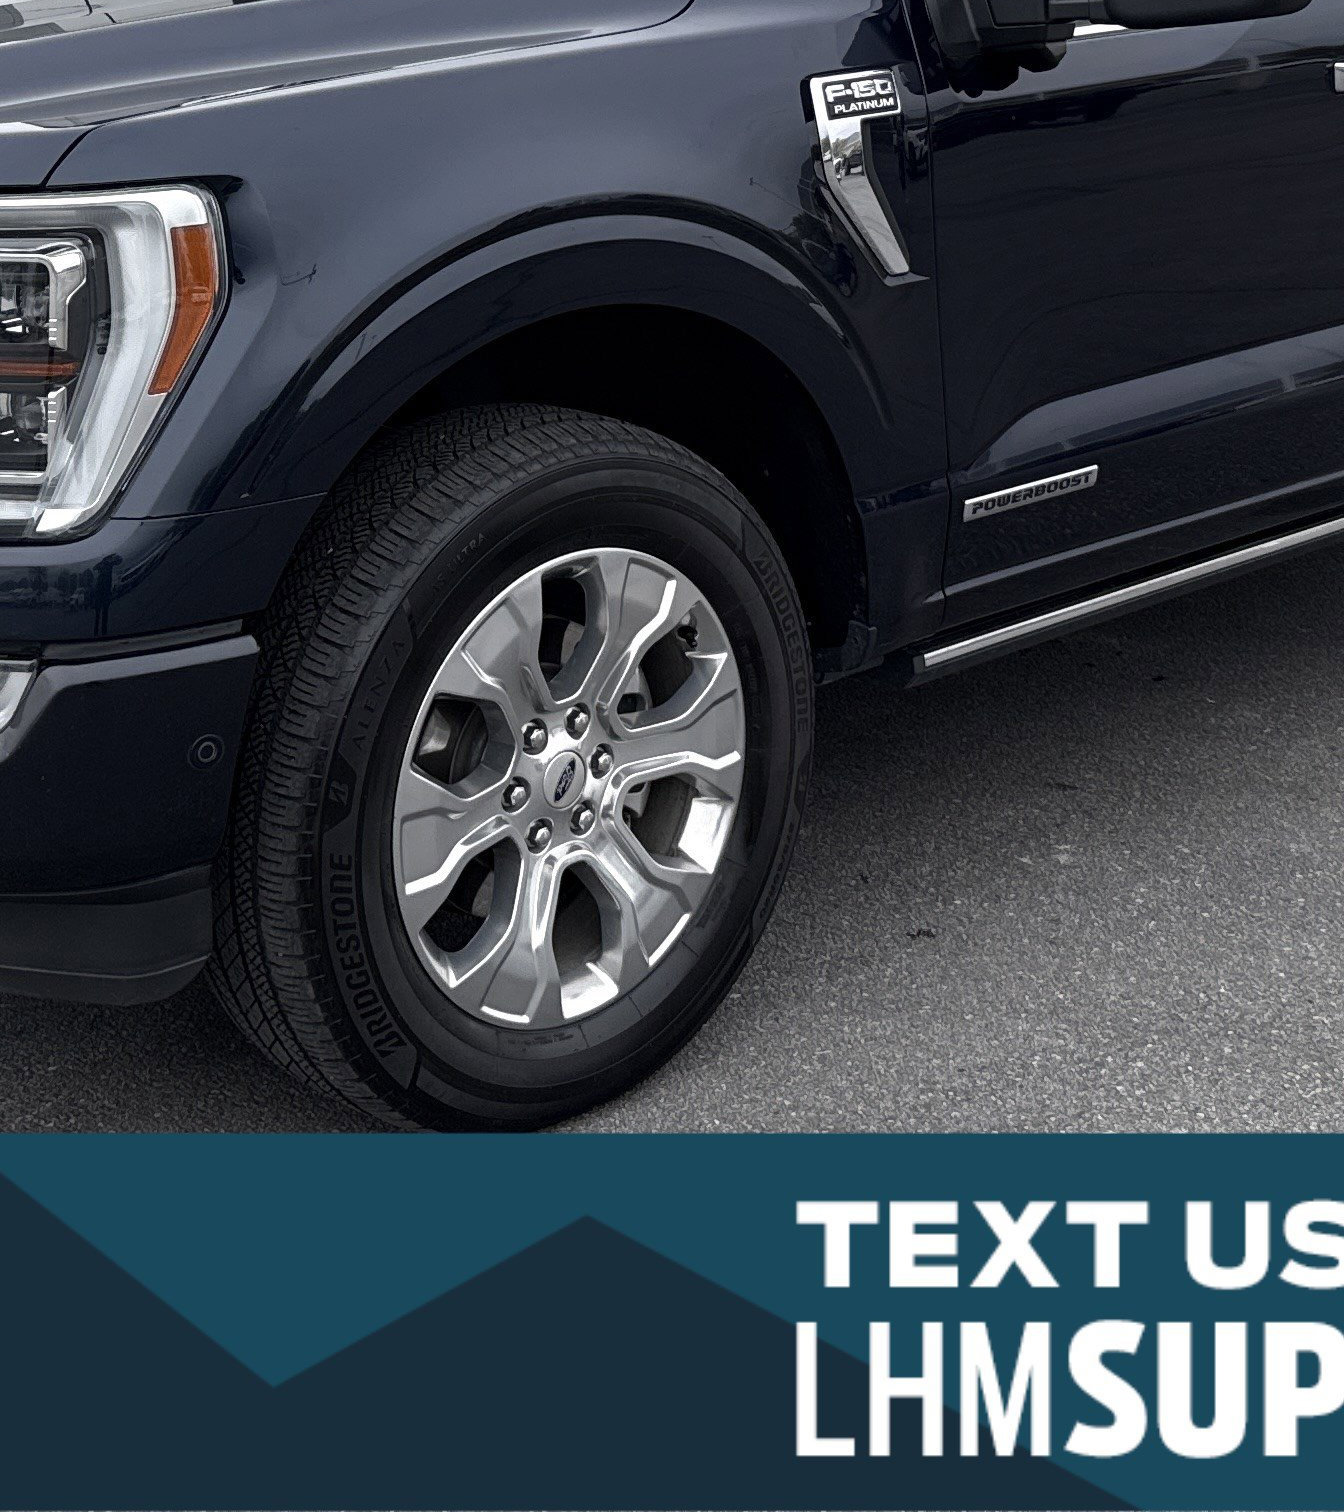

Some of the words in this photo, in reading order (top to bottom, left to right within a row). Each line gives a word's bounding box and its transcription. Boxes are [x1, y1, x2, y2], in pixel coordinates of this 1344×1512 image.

[824, 78, 895, 103] F-150
[833, 96, 895, 114] PLATINUM
[971, 472, 1094, 515] POWERBOOST
[328, 851, 411, 1063] BRIDGESTONE
